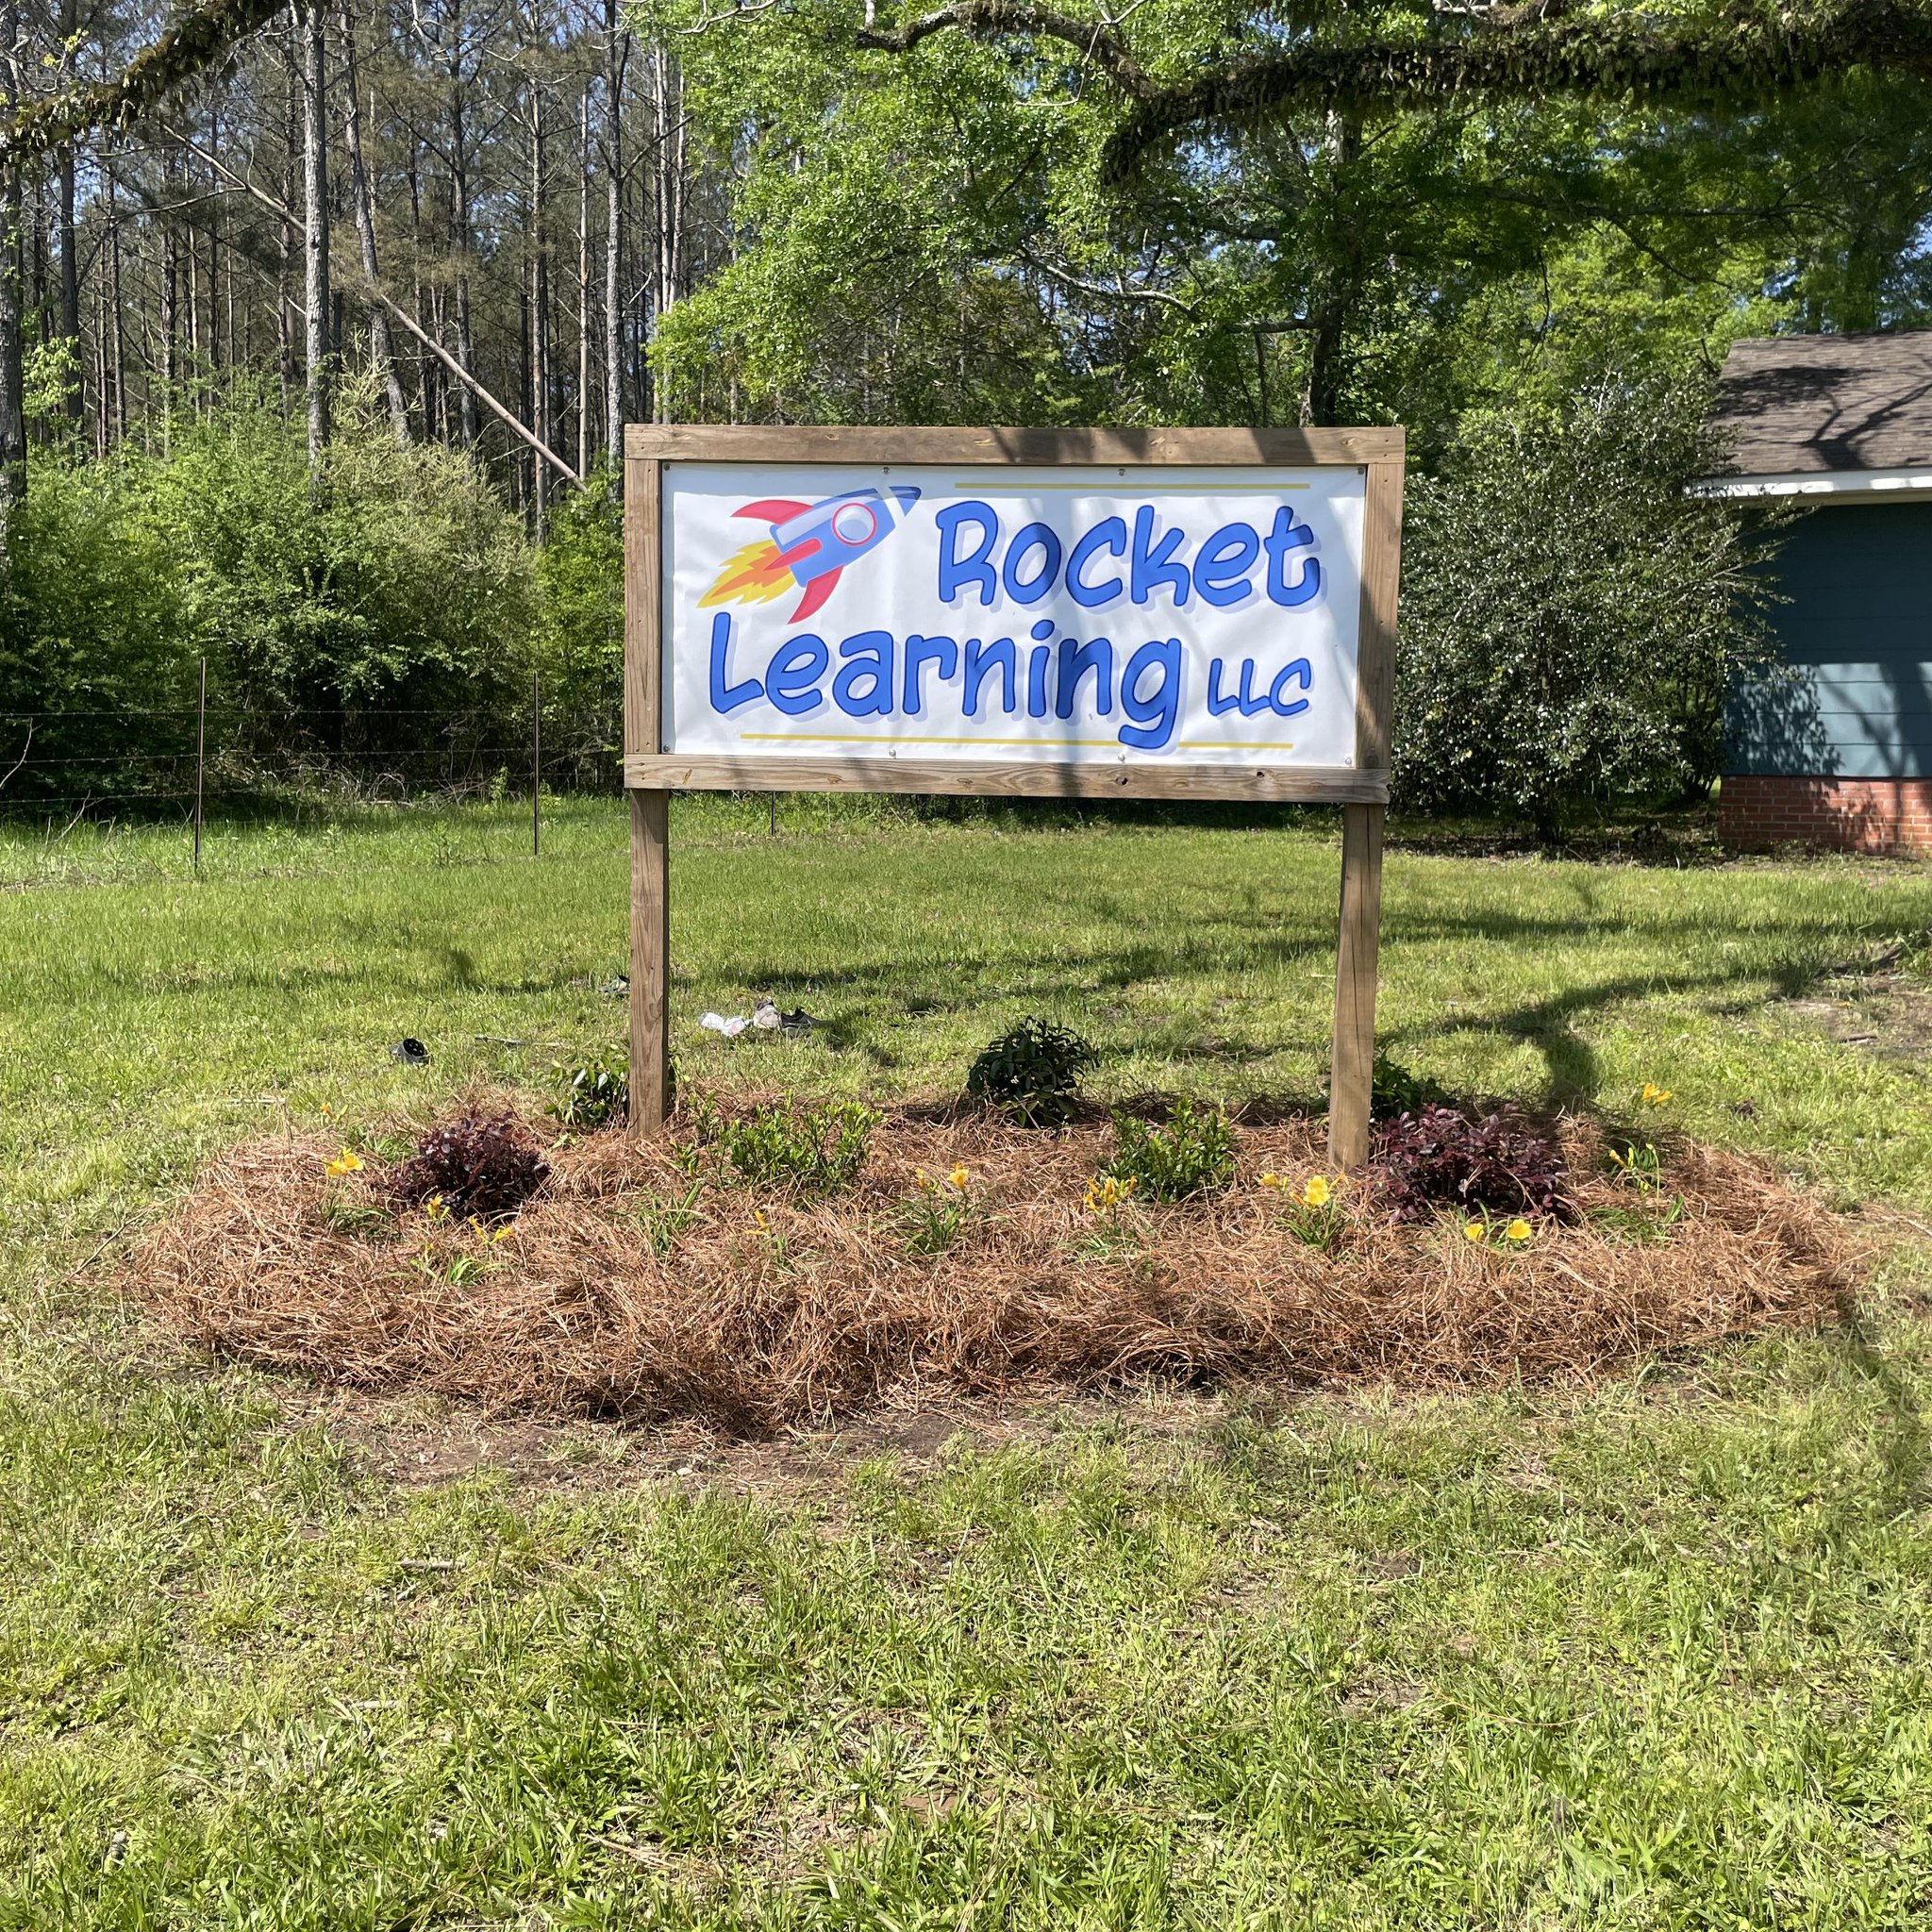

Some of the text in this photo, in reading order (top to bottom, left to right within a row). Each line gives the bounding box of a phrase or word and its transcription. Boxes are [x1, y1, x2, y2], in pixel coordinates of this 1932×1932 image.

[936, 500, 1322, 608] Rocket
[709, 611, 1312, 750] Learning LLC
